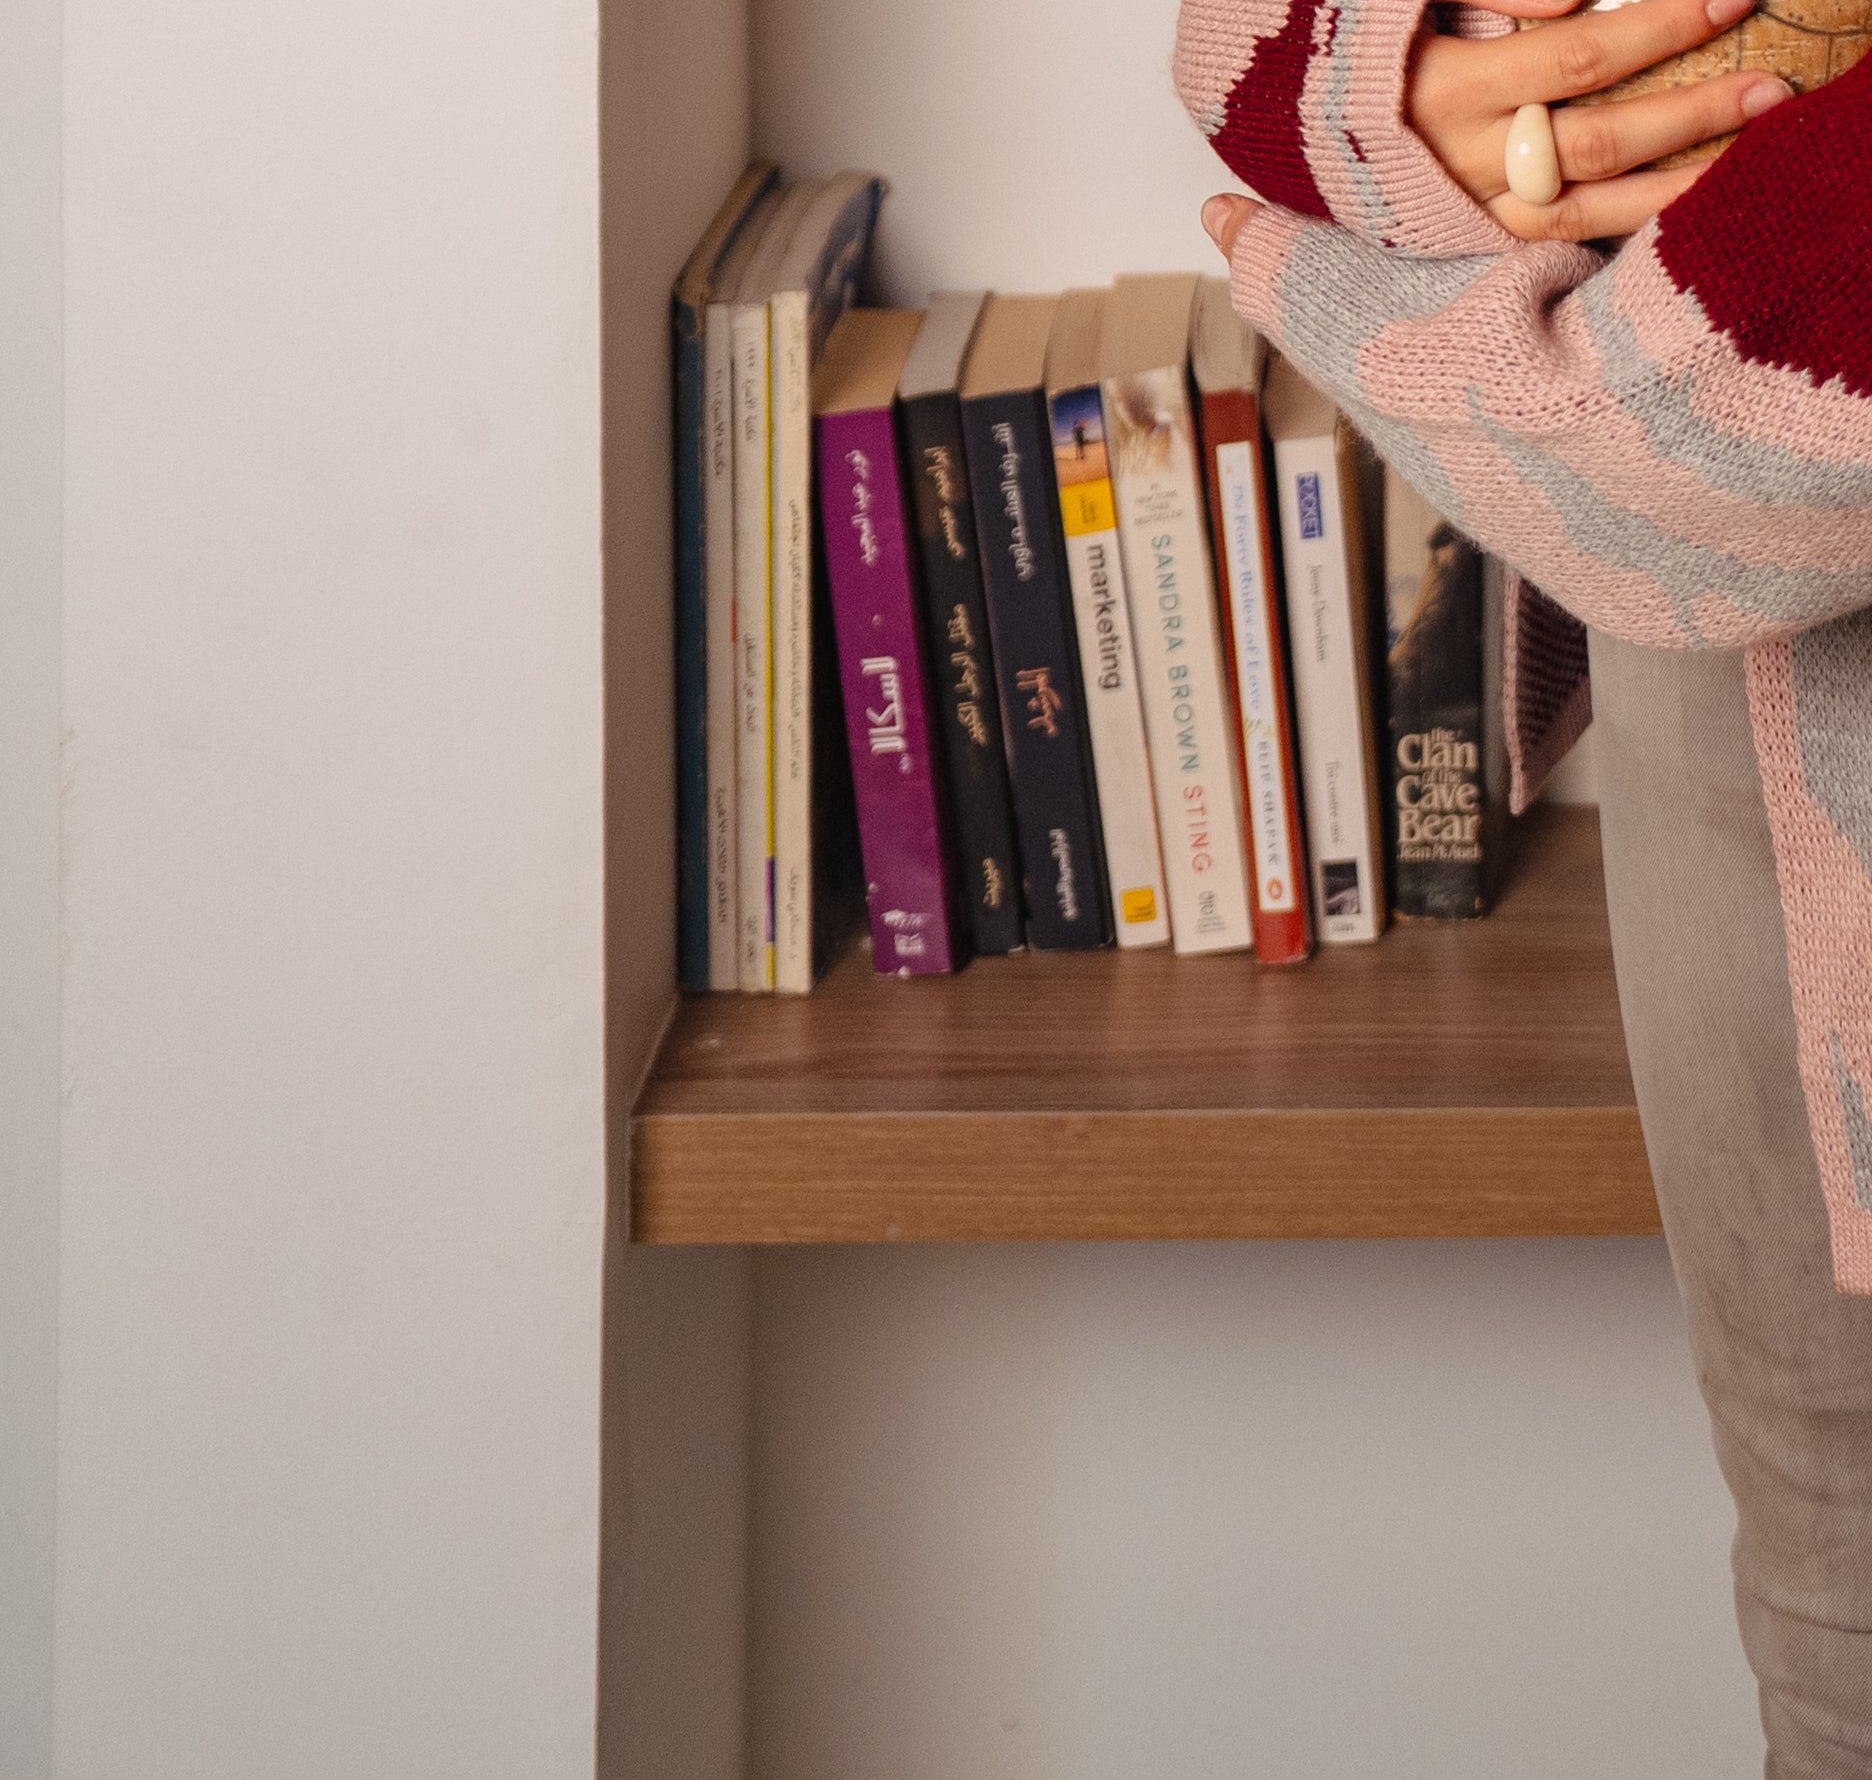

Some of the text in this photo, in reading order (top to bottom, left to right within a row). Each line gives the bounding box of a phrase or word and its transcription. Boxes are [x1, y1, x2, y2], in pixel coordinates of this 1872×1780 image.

[1298, 473, 1323, 539] POCKET
[1234, 514, 1250, 566] Forty
[1086, 542, 1122, 691] marketing
[1239, 570, 1256, 625] Rules
[1151, 533, 1201, 772] SANDRA BROWN
[1244, 632, 1259, 656] of
[1247, 659, 1262, 711] Love
[1396, 733, 1479, 773] Clan
[1396, 775, 1480, 813] Cave
[1182, 784, 1213, 874] STING
[1399, 808, 1482, 846] Bear
